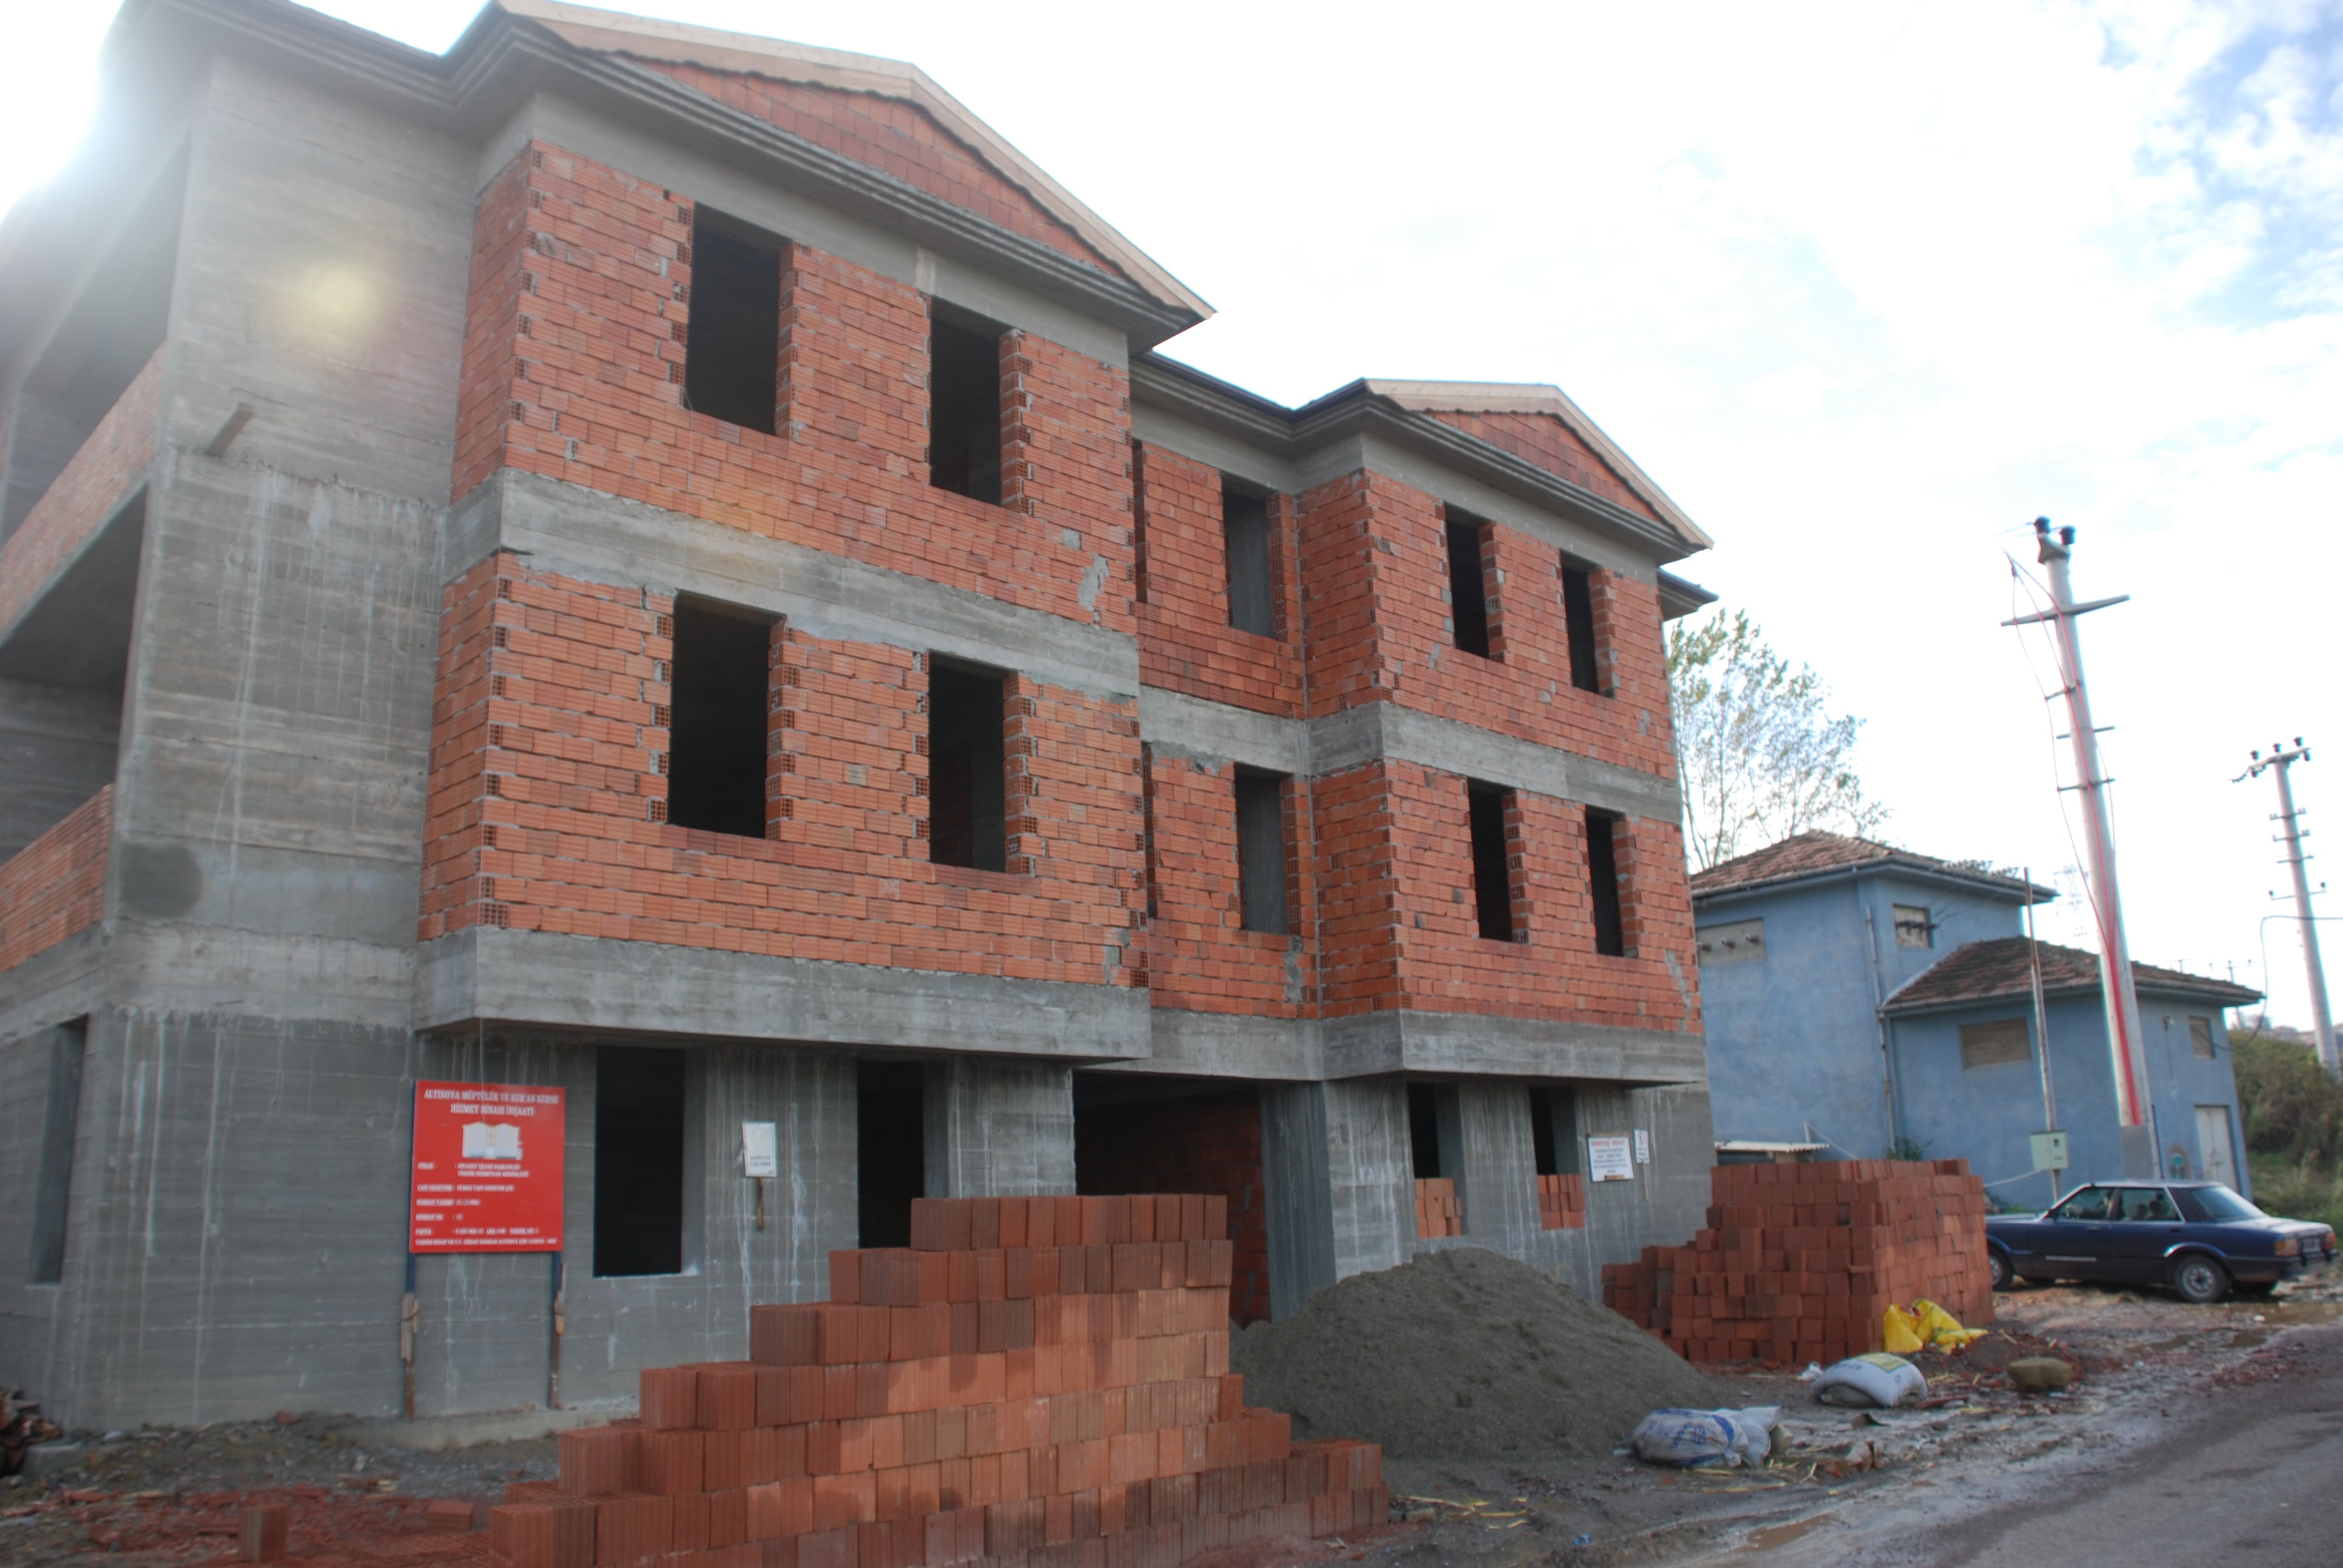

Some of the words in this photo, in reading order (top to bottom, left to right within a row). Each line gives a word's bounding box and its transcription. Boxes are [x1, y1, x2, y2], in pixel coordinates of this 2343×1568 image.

[424, 1089, 460, 1100] ALTINOVA
[462, 1089, 499, 1101] MÜFTÜLÜK
[500, 1093, 509, 1101] VE
[511, 1093, 535, 1103] KUR'AN
[537, 1094, 559, 1105] KURSU
[450, 1103, 479, 1114] HİZMET
[480, 1104, 505, 1114] BİNASI
[506, 1105, 535, 1117] İNŞAATI
